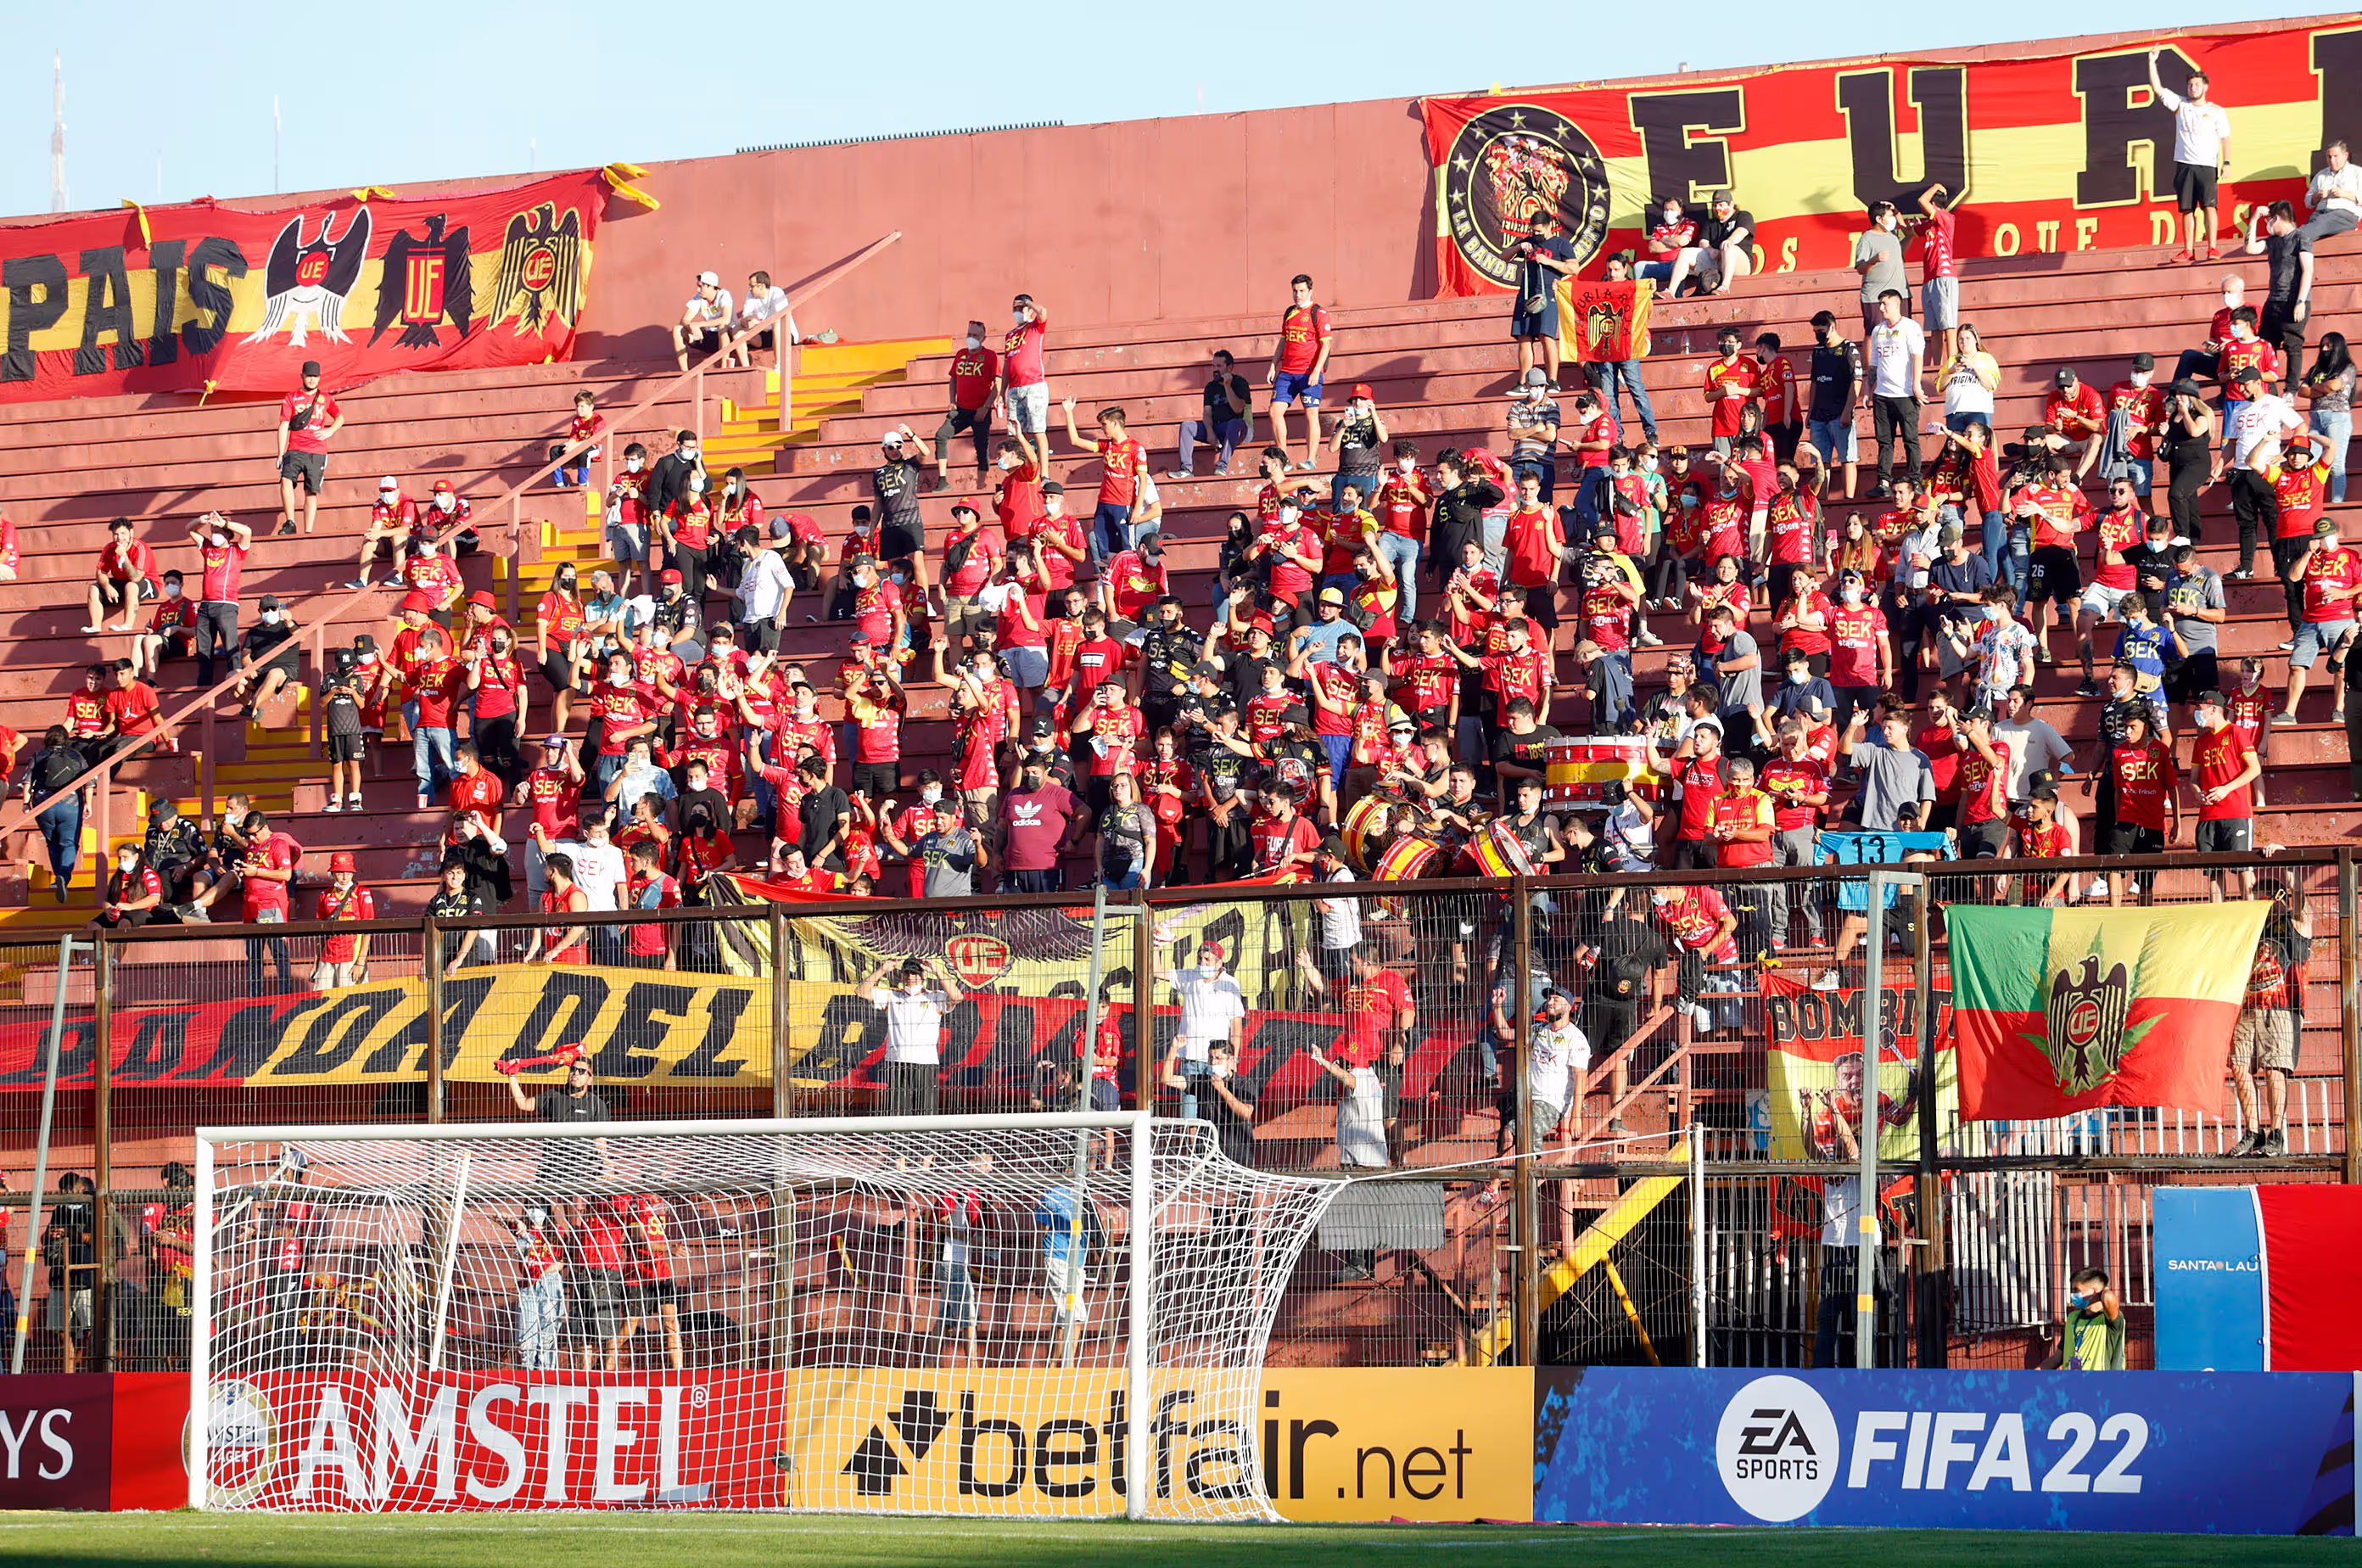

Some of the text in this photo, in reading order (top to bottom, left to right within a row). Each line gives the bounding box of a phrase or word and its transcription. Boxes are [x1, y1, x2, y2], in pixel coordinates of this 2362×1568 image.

[1452, 209, 1471, 239] LA
[1464, 240, 1518, 282] BANDA
[301, 260, 325, 279] UE
[526, 257, 552, 281] UE
[407, 257, 441, 321] UE
[1005, 333, 1026, 350] SEK
[1876, 344, 1900, 357] SEK
[956, 362, 982, 376] SEK
[2230, 355, 2258, 369] SEK
[2237, 414, 2266, 429] SEK
[621, 479, 642, 490] SEK
[876, 469, 906, 491] SEK
[1936, 472, 1961, 484] SEK
[687, 515, 709, 525] SEK
[1773, 506, 1797, 521] SEK
[410, 566, 440, 580] SEK
[2032, 565, 2045, 577] 26
[2170, 590, 2198, 605] SEK
[1586, 598, 1616, 614] SEK
[1837, 621, 1871, 637] SEK
[1838, 638, 1867, 647] starken
[420, 675, 445, 686] SEK
[1413, 669, 1440, 686] SEK
[1503, 669, 1532, 686] SEK
[76, 705, 103, 719] SEK
[606, 697, 635, 711] SEK
[2235, 702, 2264, 715] SEK
[1097, 719, 1128, 734] SEK
[2203, 748, 2226, 765] SEK
[1212, 759, 1240, 775] SEK
[1963, 761, 1990, 781] SEK
[2122, 761, 2158, 781] SEK
[534, 781, 562, 795] SEK
[1012, 818, 1041, 827] adidas
[1104, 813, 1131, 827] SK
[1851, 835, 1886, 864] 13
[922, 850, 949, 869] SEK
[954, 942, 1004, 976] UE
[1346, 998, 1373, 1012] SEK
[499, 972, 753, 1077] DEL
[2071, 1007, 2099, 1035] UE
[2168, 1259, 2217, 1271] SANTA
[1739, 1408, 1816, 1456] EA
[293, 1384, 711, 1503] AMSTEL
[1848, 1412, 2149, 1494] FIFA 22
[1736, 1459, 1818, 1481] SPORTS
